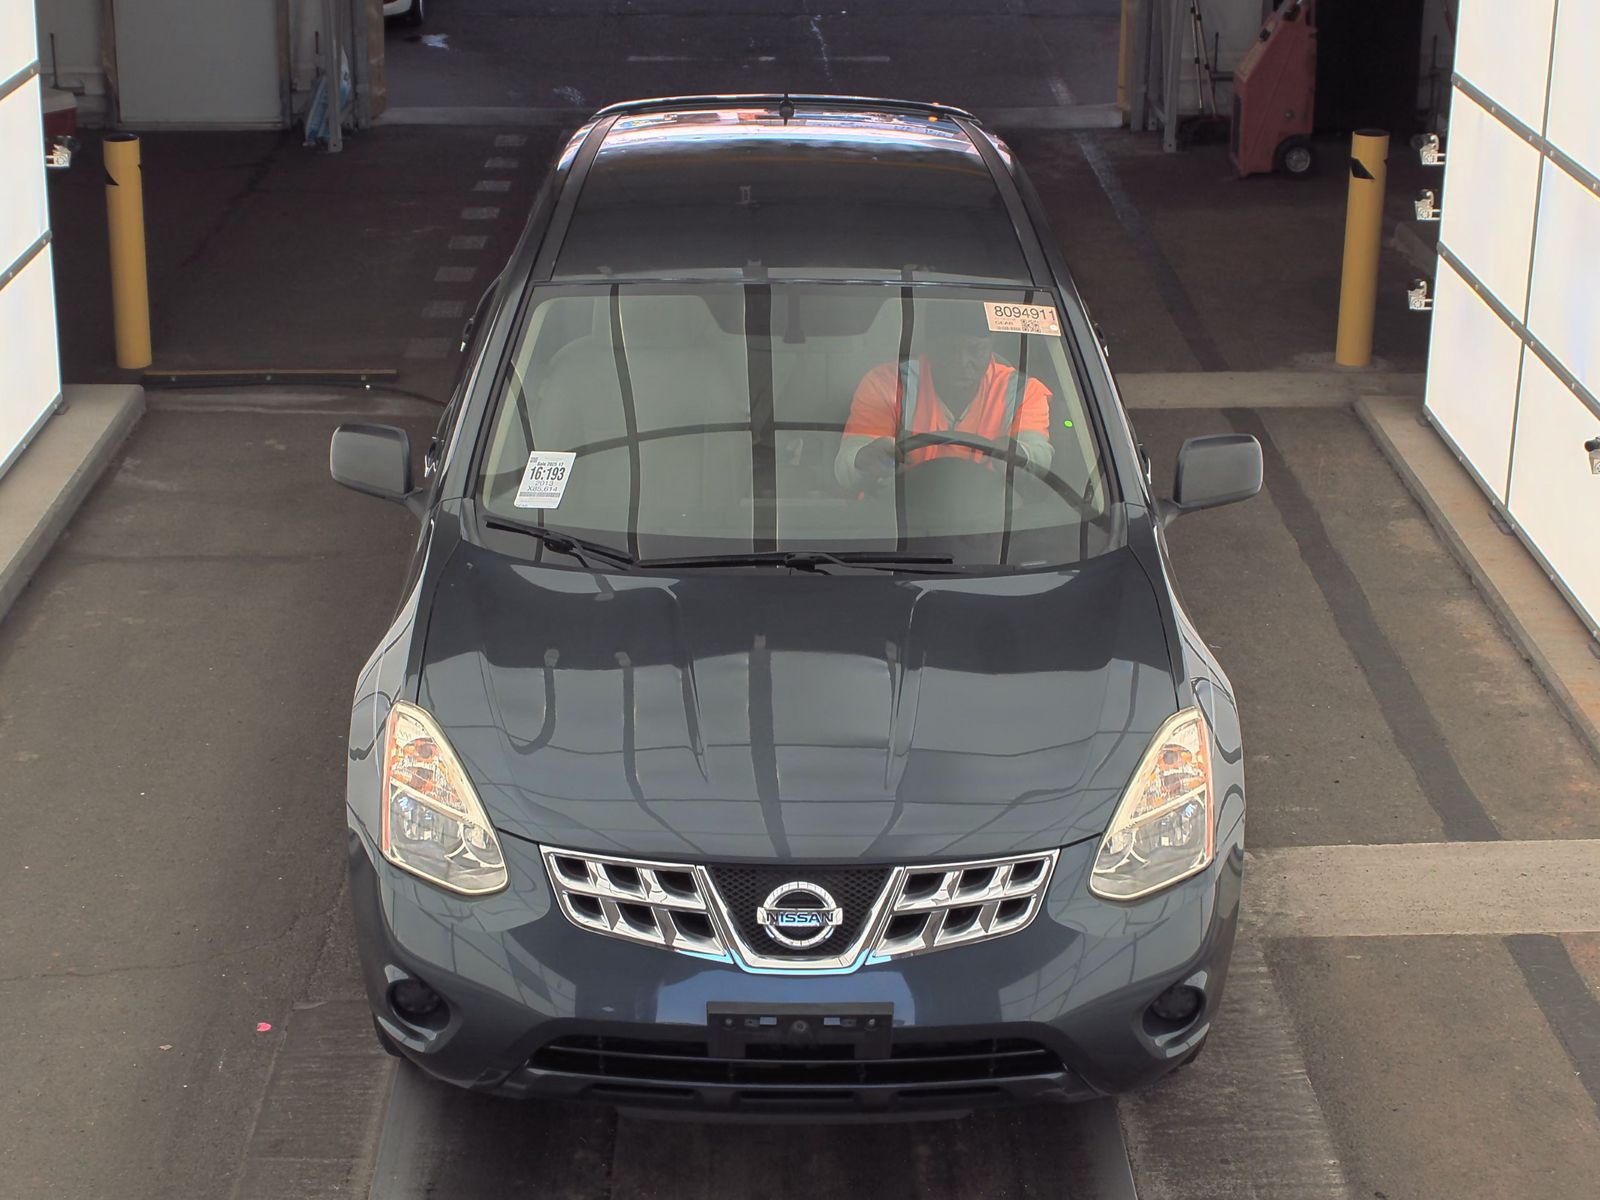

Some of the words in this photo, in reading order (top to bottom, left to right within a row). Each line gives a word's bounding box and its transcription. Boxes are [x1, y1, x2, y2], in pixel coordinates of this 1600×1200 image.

[994, 305, 1056, 321] 8094911
[530, 466, 566, 481] 16:193
[766, 911, 834, 923] NISSAN
